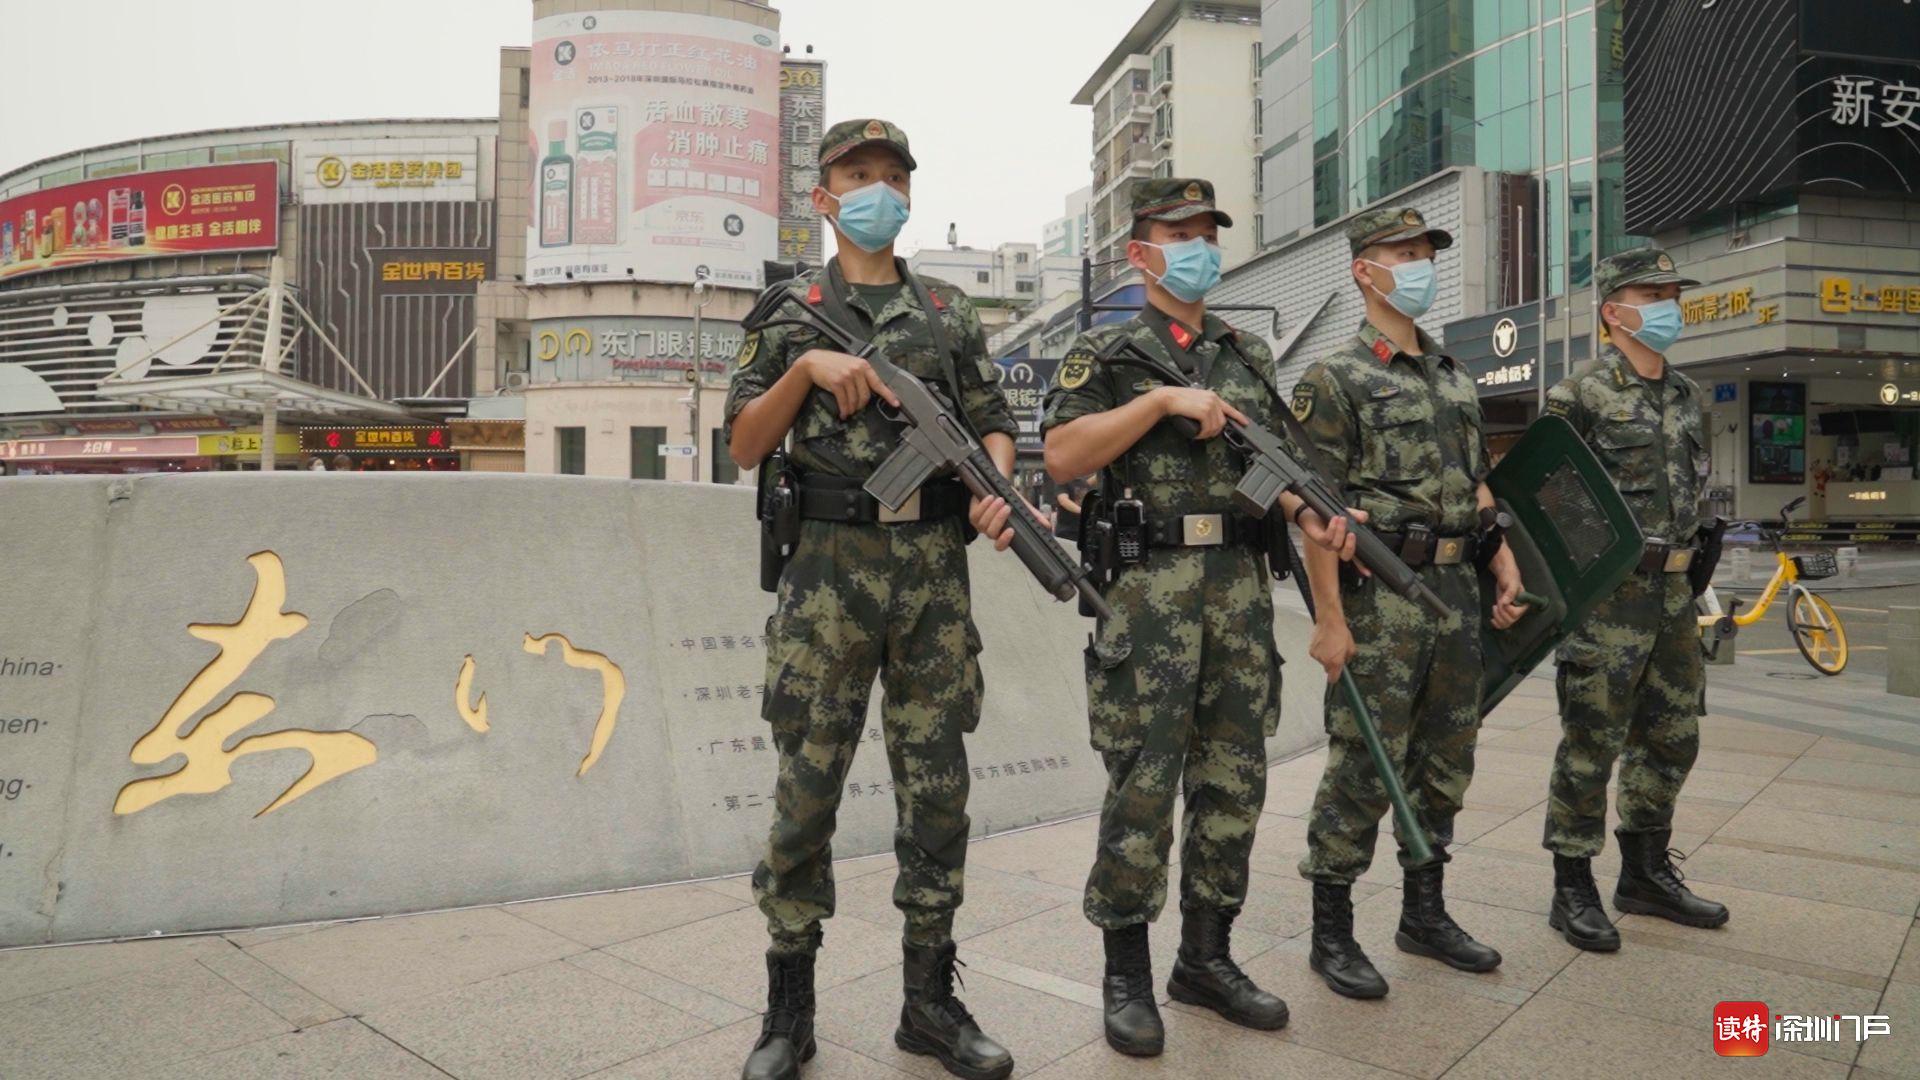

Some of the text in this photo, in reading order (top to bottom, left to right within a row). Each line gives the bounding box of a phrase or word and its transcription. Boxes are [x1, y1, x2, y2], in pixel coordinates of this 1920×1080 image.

[646, 100, 749, 131] 活血散寒
[667, 129, 769, 167] 消肿止痛
[351, 161, 462, 179] 金活医药集团
[382, 262, 485, 281] 金世界百货
[1756, 304, 1779, 325] 3F
[601, 329, 743, 360] 东门眼镜城
[0, 657, 55, 677] hina
